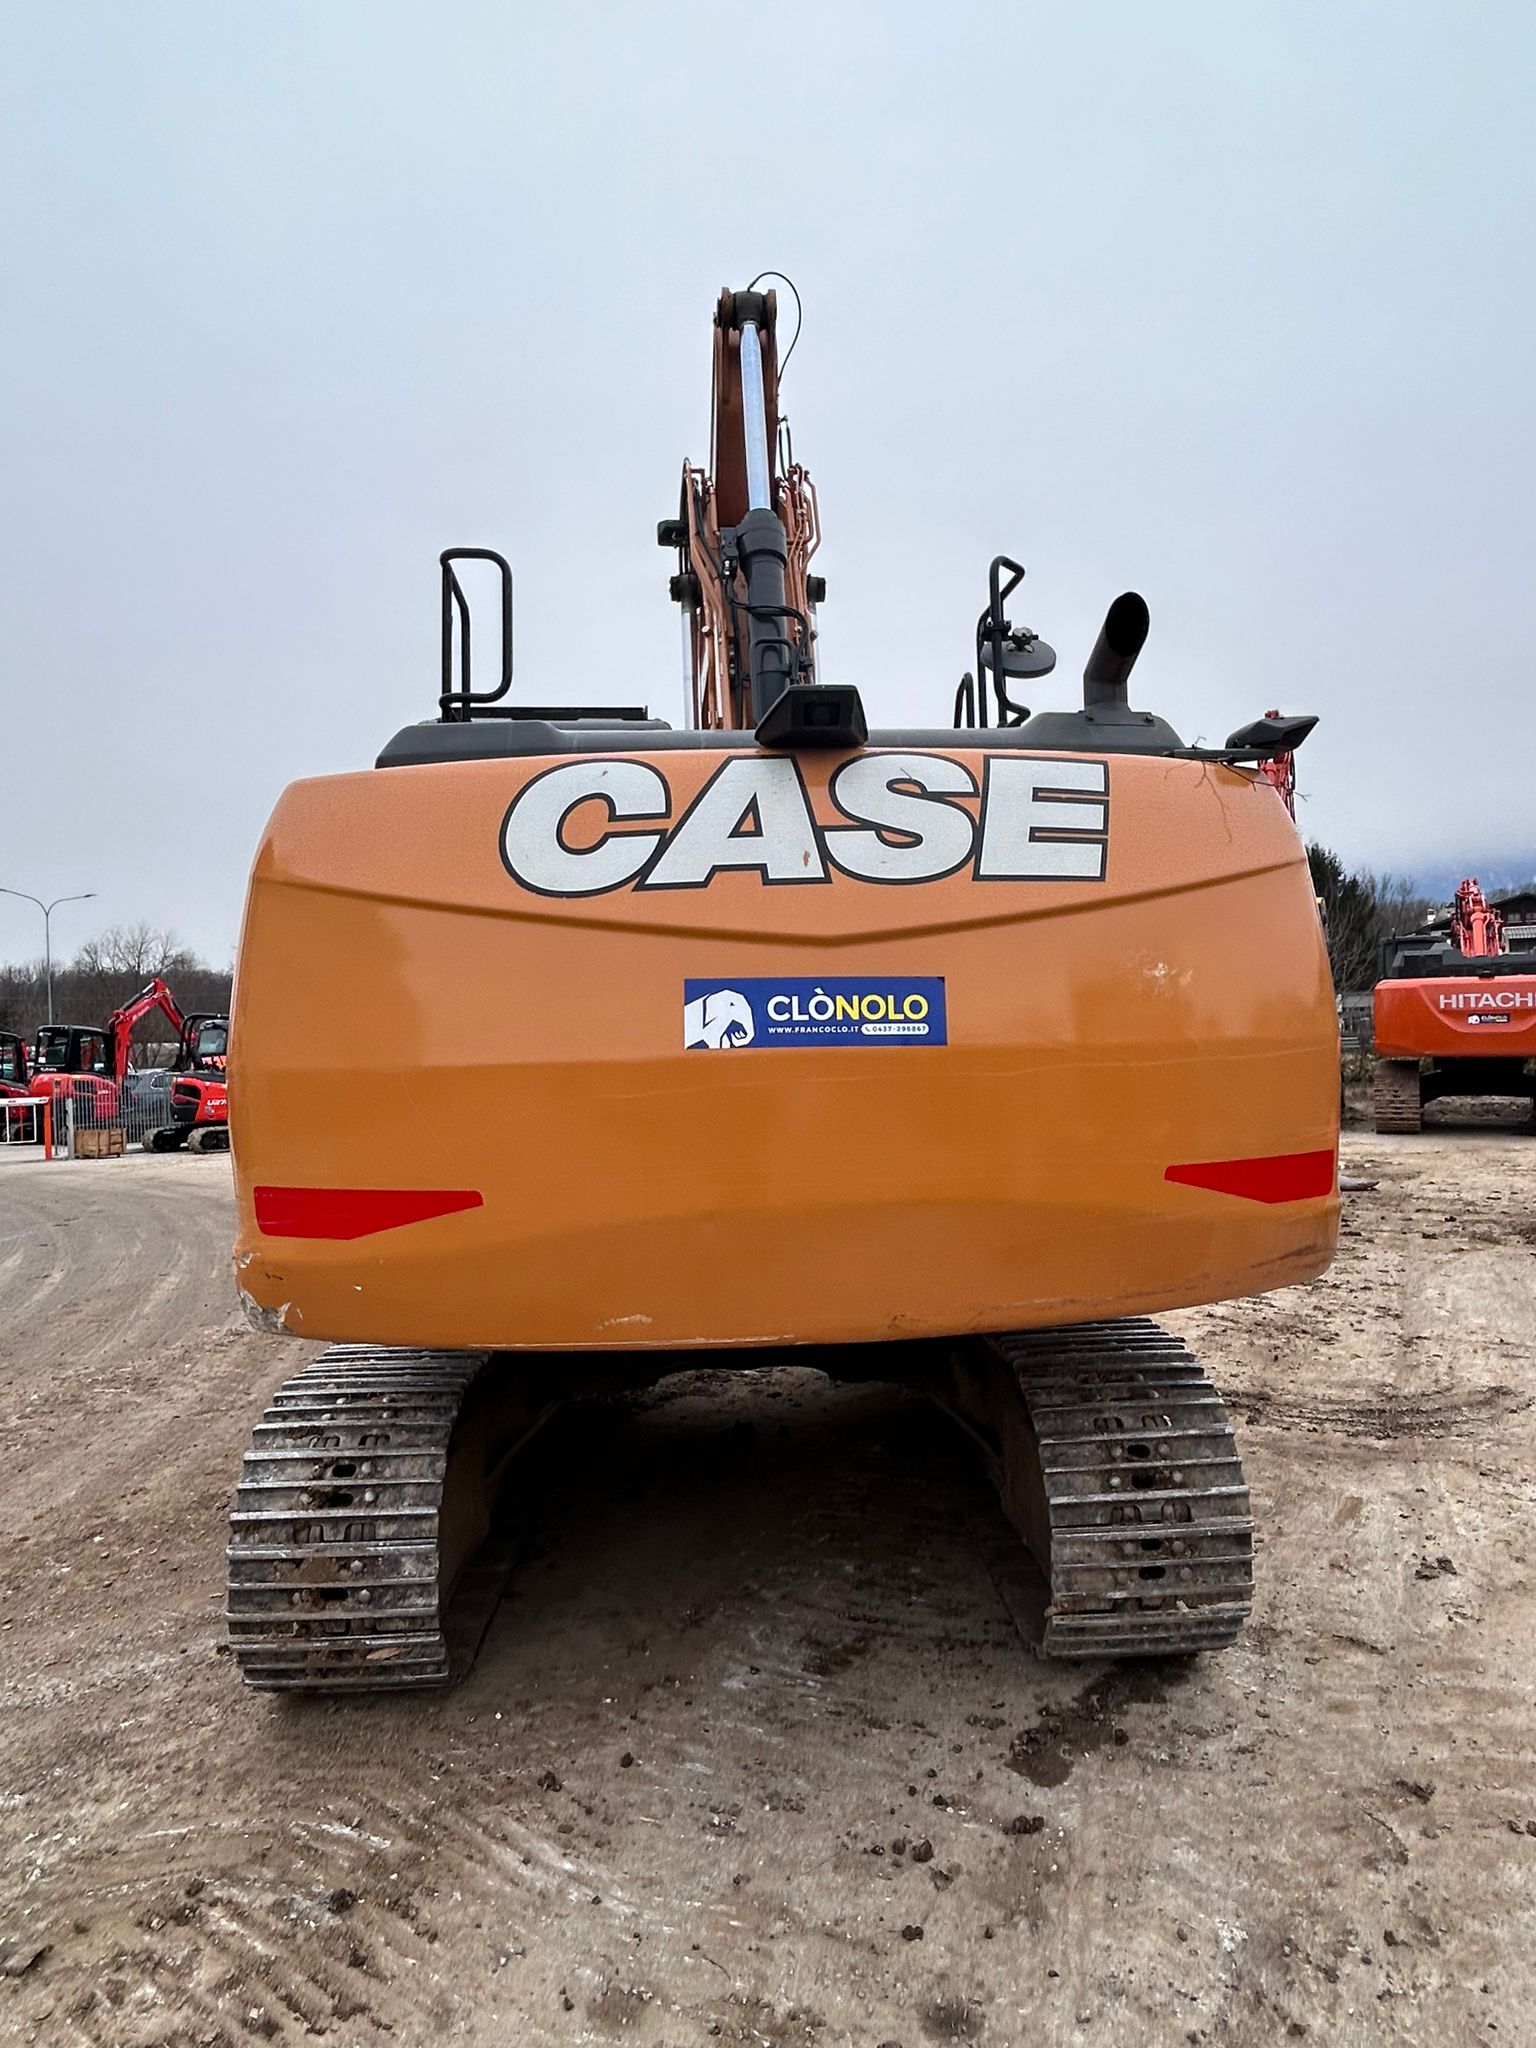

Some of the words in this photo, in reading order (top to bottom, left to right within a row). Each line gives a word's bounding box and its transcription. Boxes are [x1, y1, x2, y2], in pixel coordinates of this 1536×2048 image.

[499, 752, 1111, 898] CASE
[1439, 992, 1536, 1009] HITACH
[768, 1025, 859, 1034] WWW.FRANCOCLO.IT
